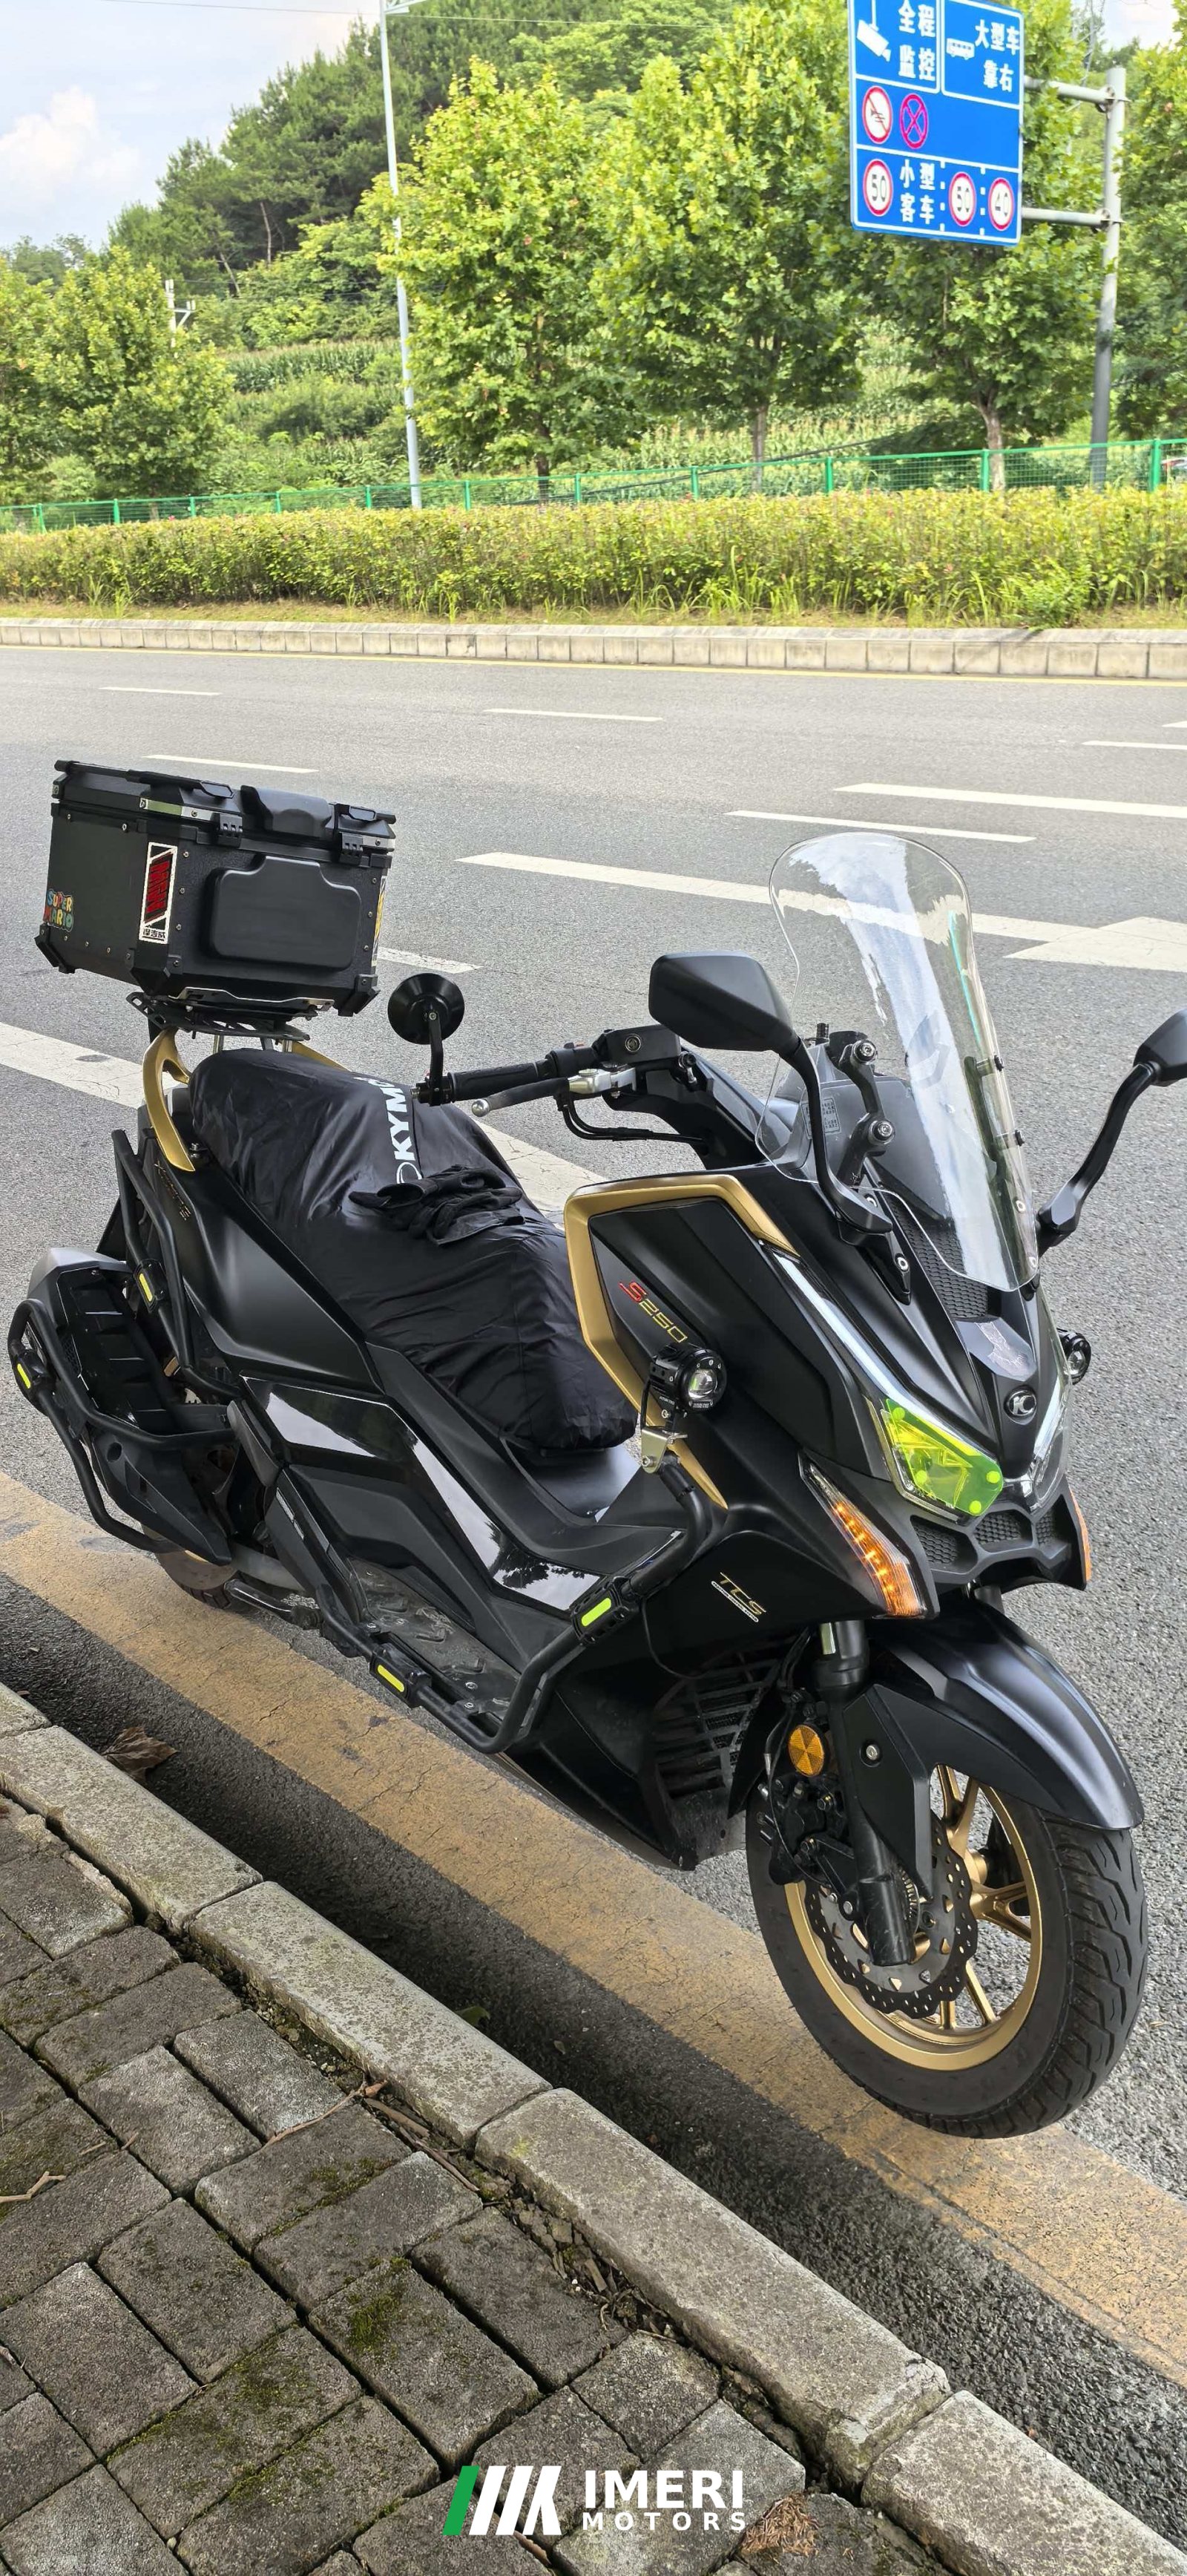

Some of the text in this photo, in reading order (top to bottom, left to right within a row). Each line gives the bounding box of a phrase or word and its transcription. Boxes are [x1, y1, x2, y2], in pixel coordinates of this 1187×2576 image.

[898, 0, 936, 37] 全程
[975, 19, 1021, 55] 大型车
[898, 45, 936, 81] 监控
[984, 60, 1013, 92] 靠右
[871, 174, 887, 203] 50
[900, 159, 935, 191] 小型
[900, 192, 935, 224] 客车
[956, 186, 970, 213] 50
[994, 192, 1010, 217] 40
[47, 891, 72, 912] SUPER
[720, 1572, 766, 1615] TCS
